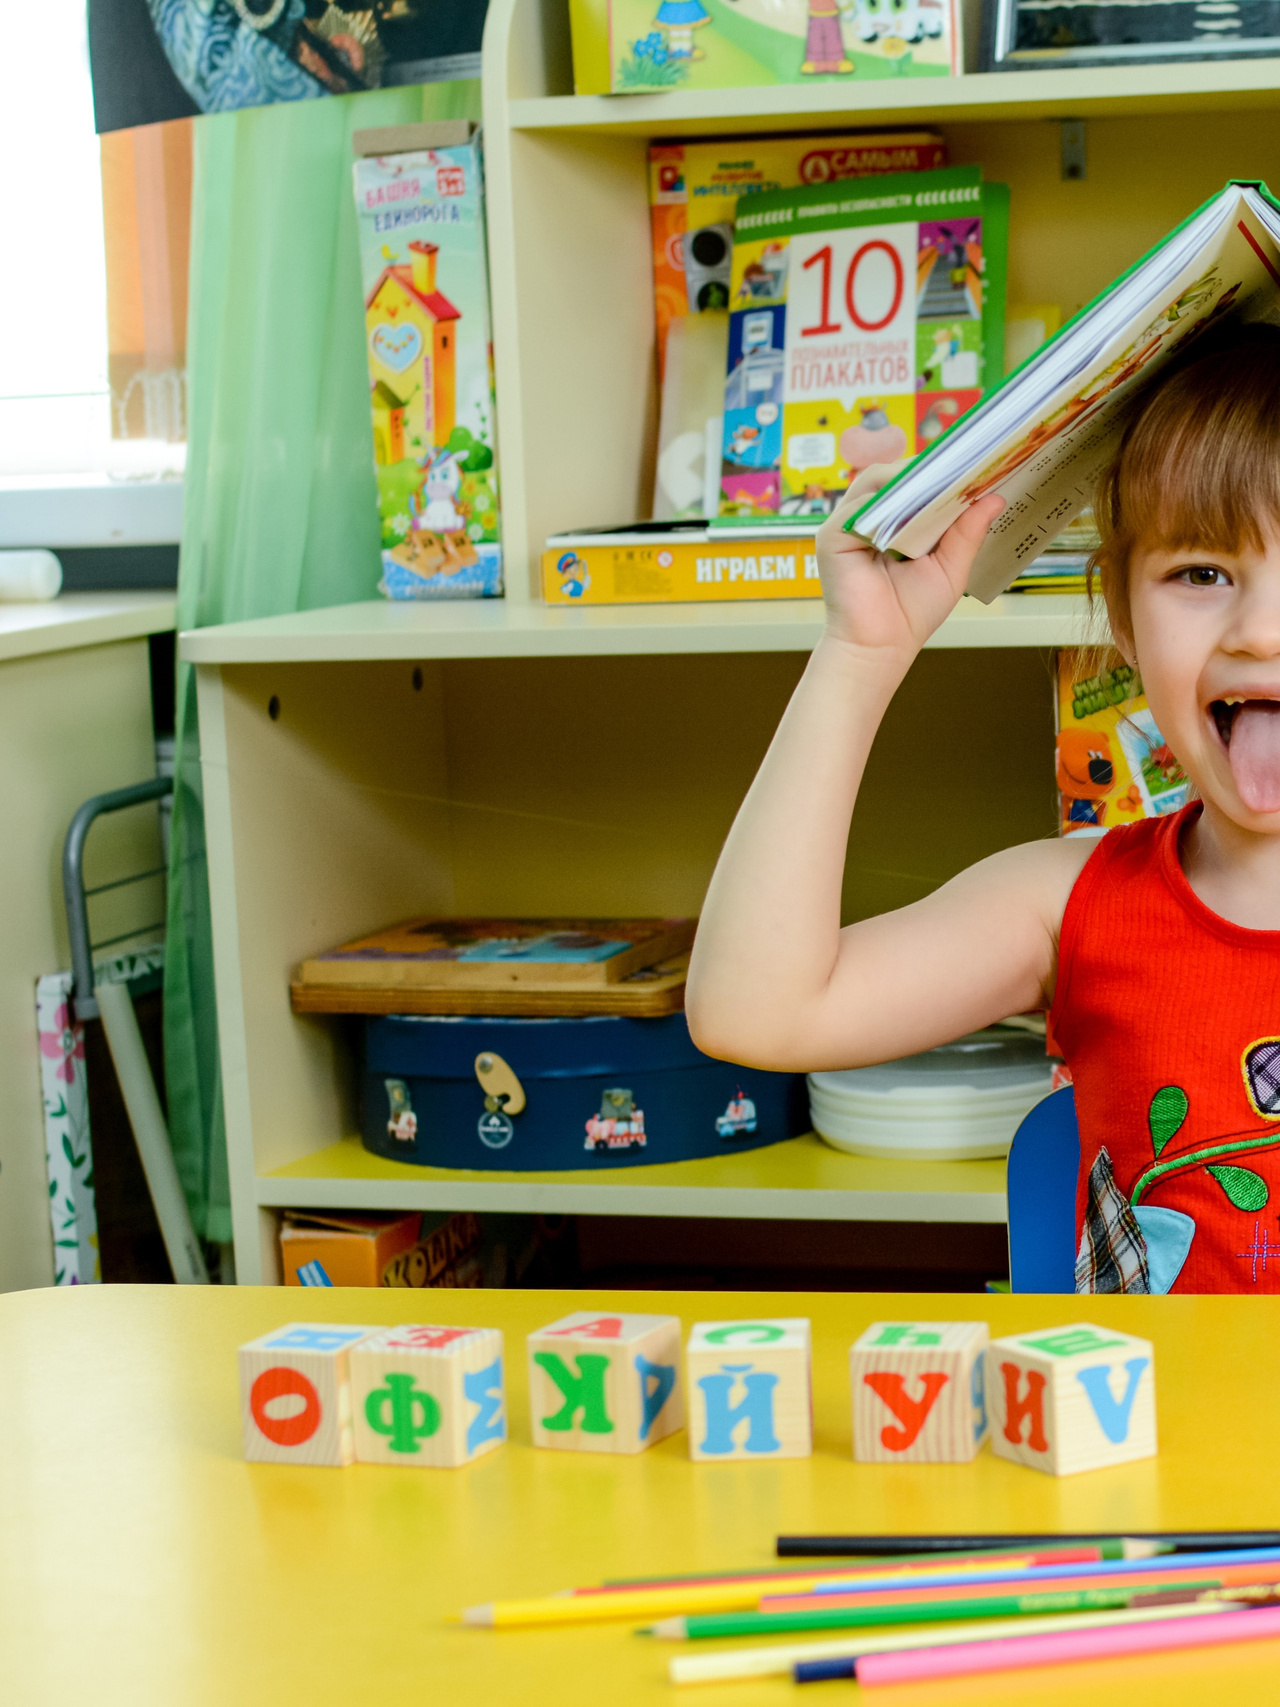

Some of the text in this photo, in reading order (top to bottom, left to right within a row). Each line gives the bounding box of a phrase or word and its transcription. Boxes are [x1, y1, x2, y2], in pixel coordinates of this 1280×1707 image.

[365, 178, 421, 209] БАШНЯ
[373, 203, 461, 233] ЕДИНОРОГА
[800, 237, 905, 338] 10
[791, 355, 910, 391] ПЛАКАТОВ
[696, 554, 796, 583] ИГРАЕМ
[364, 1371, 443, 1454] Ф
[696, 1362, 782, 1455] Й
[862, 1370, 950, 1452] У
[1000, 1360, 1050, 1453] И
